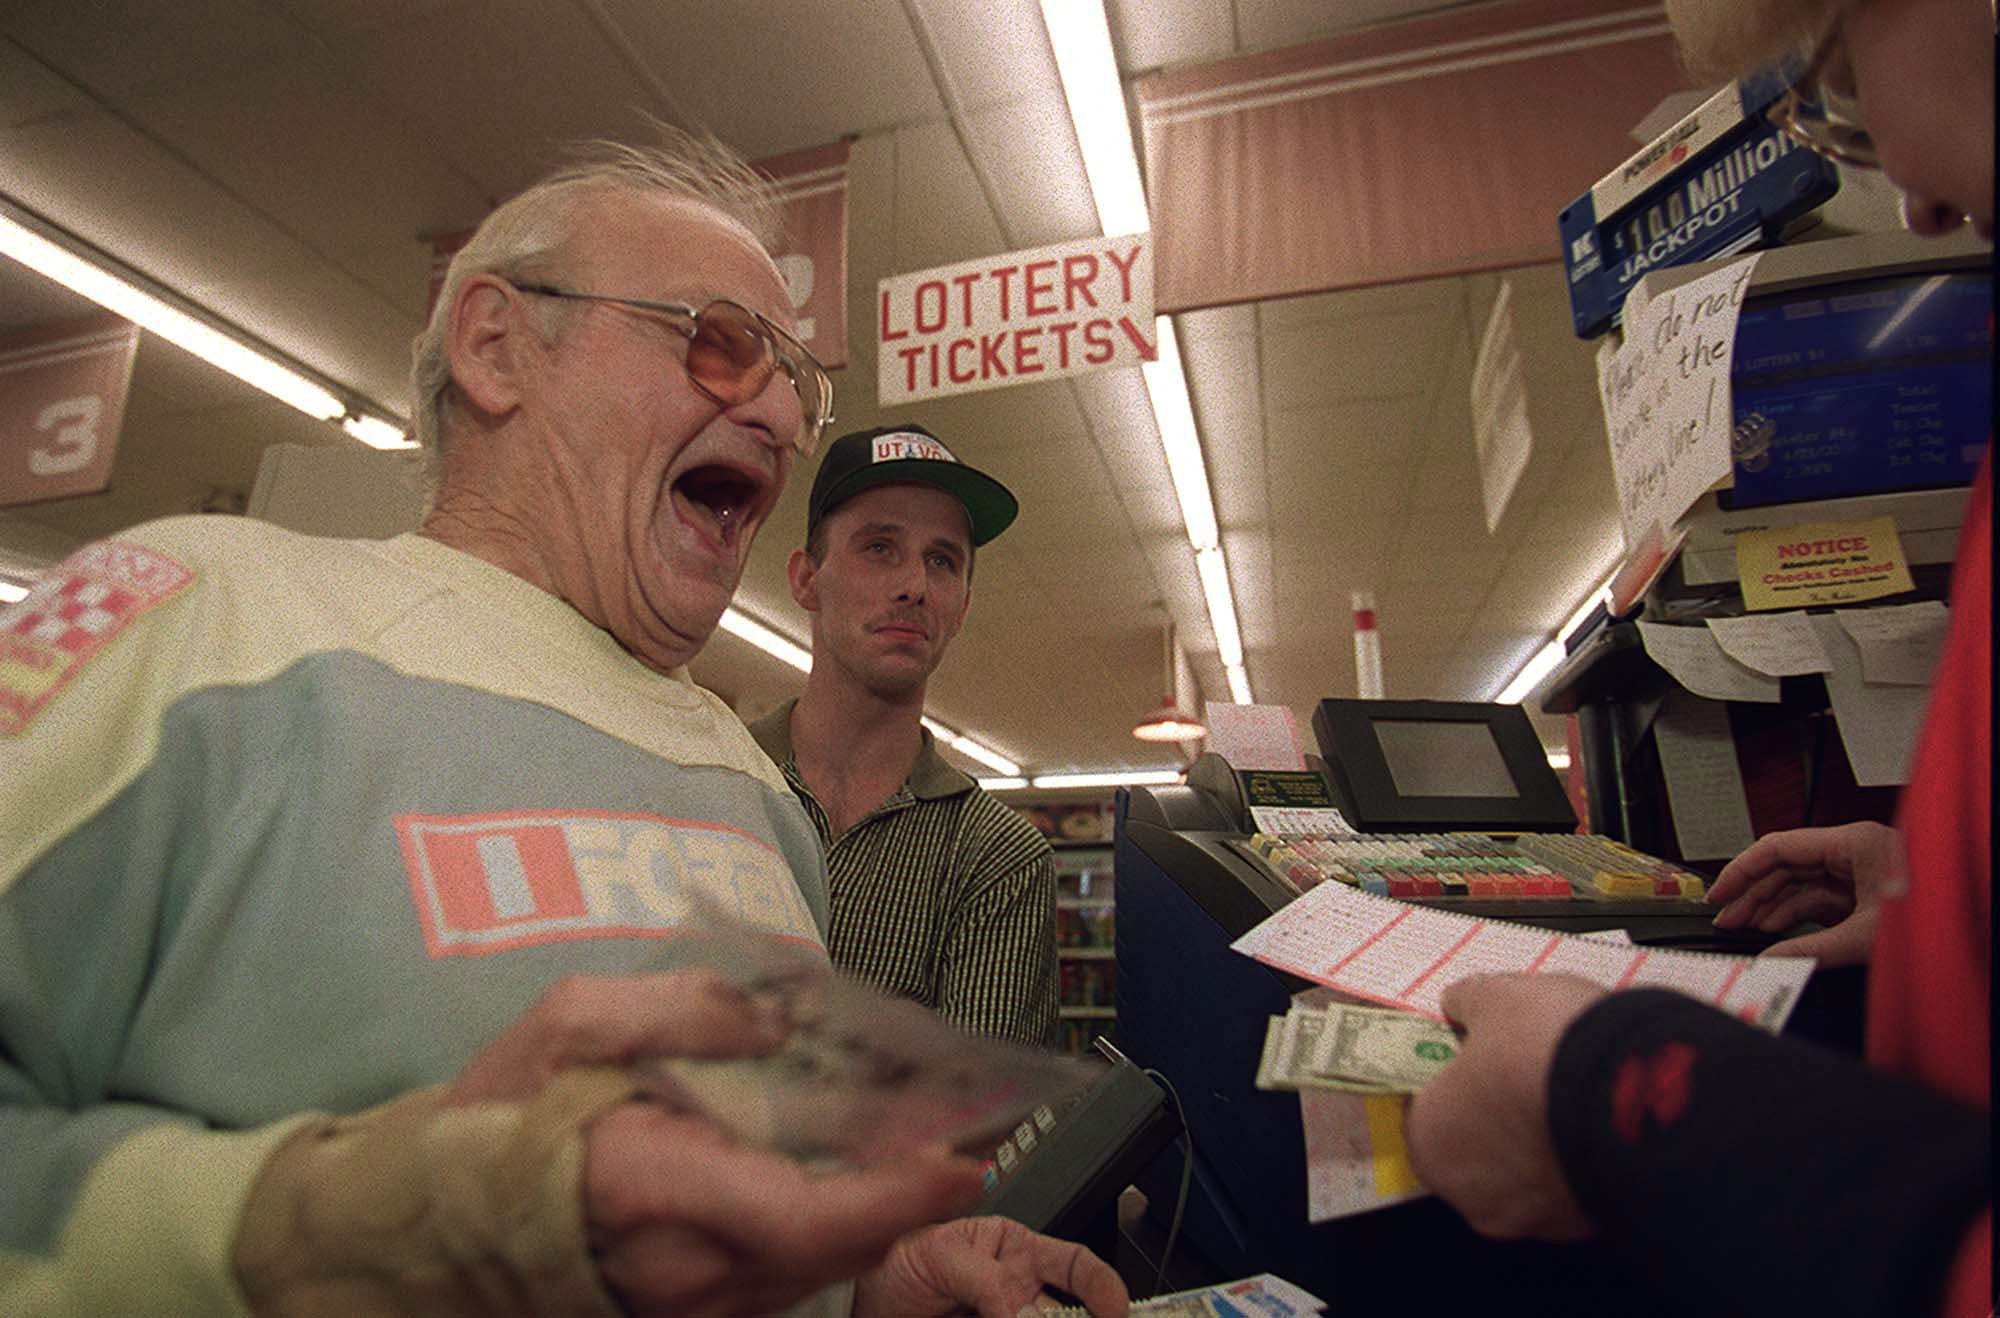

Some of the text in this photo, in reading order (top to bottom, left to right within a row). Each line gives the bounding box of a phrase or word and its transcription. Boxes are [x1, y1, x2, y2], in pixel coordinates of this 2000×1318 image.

[1686, 126, 1799, 210] Million
[1571, 230, 1595, 262] K
[1618, 189, 1745, 284] JACKPOT
[881, 245, 1141, 342] LOTTERY
[1654, 293, 1684, 354] do
[1691, 264, 1752, 326] not
[897, 318, 1115, 392] TICKETS
[1677, 333, 1727, 380] the
[31, 394, 102, 476] 3
[878, 442, 902, 459] UT
[1762, 569, 1825, 585] Checks
[1828, 561, 1895, 579] Cashed
[1778, 536, 1869, 560] NOTICE
